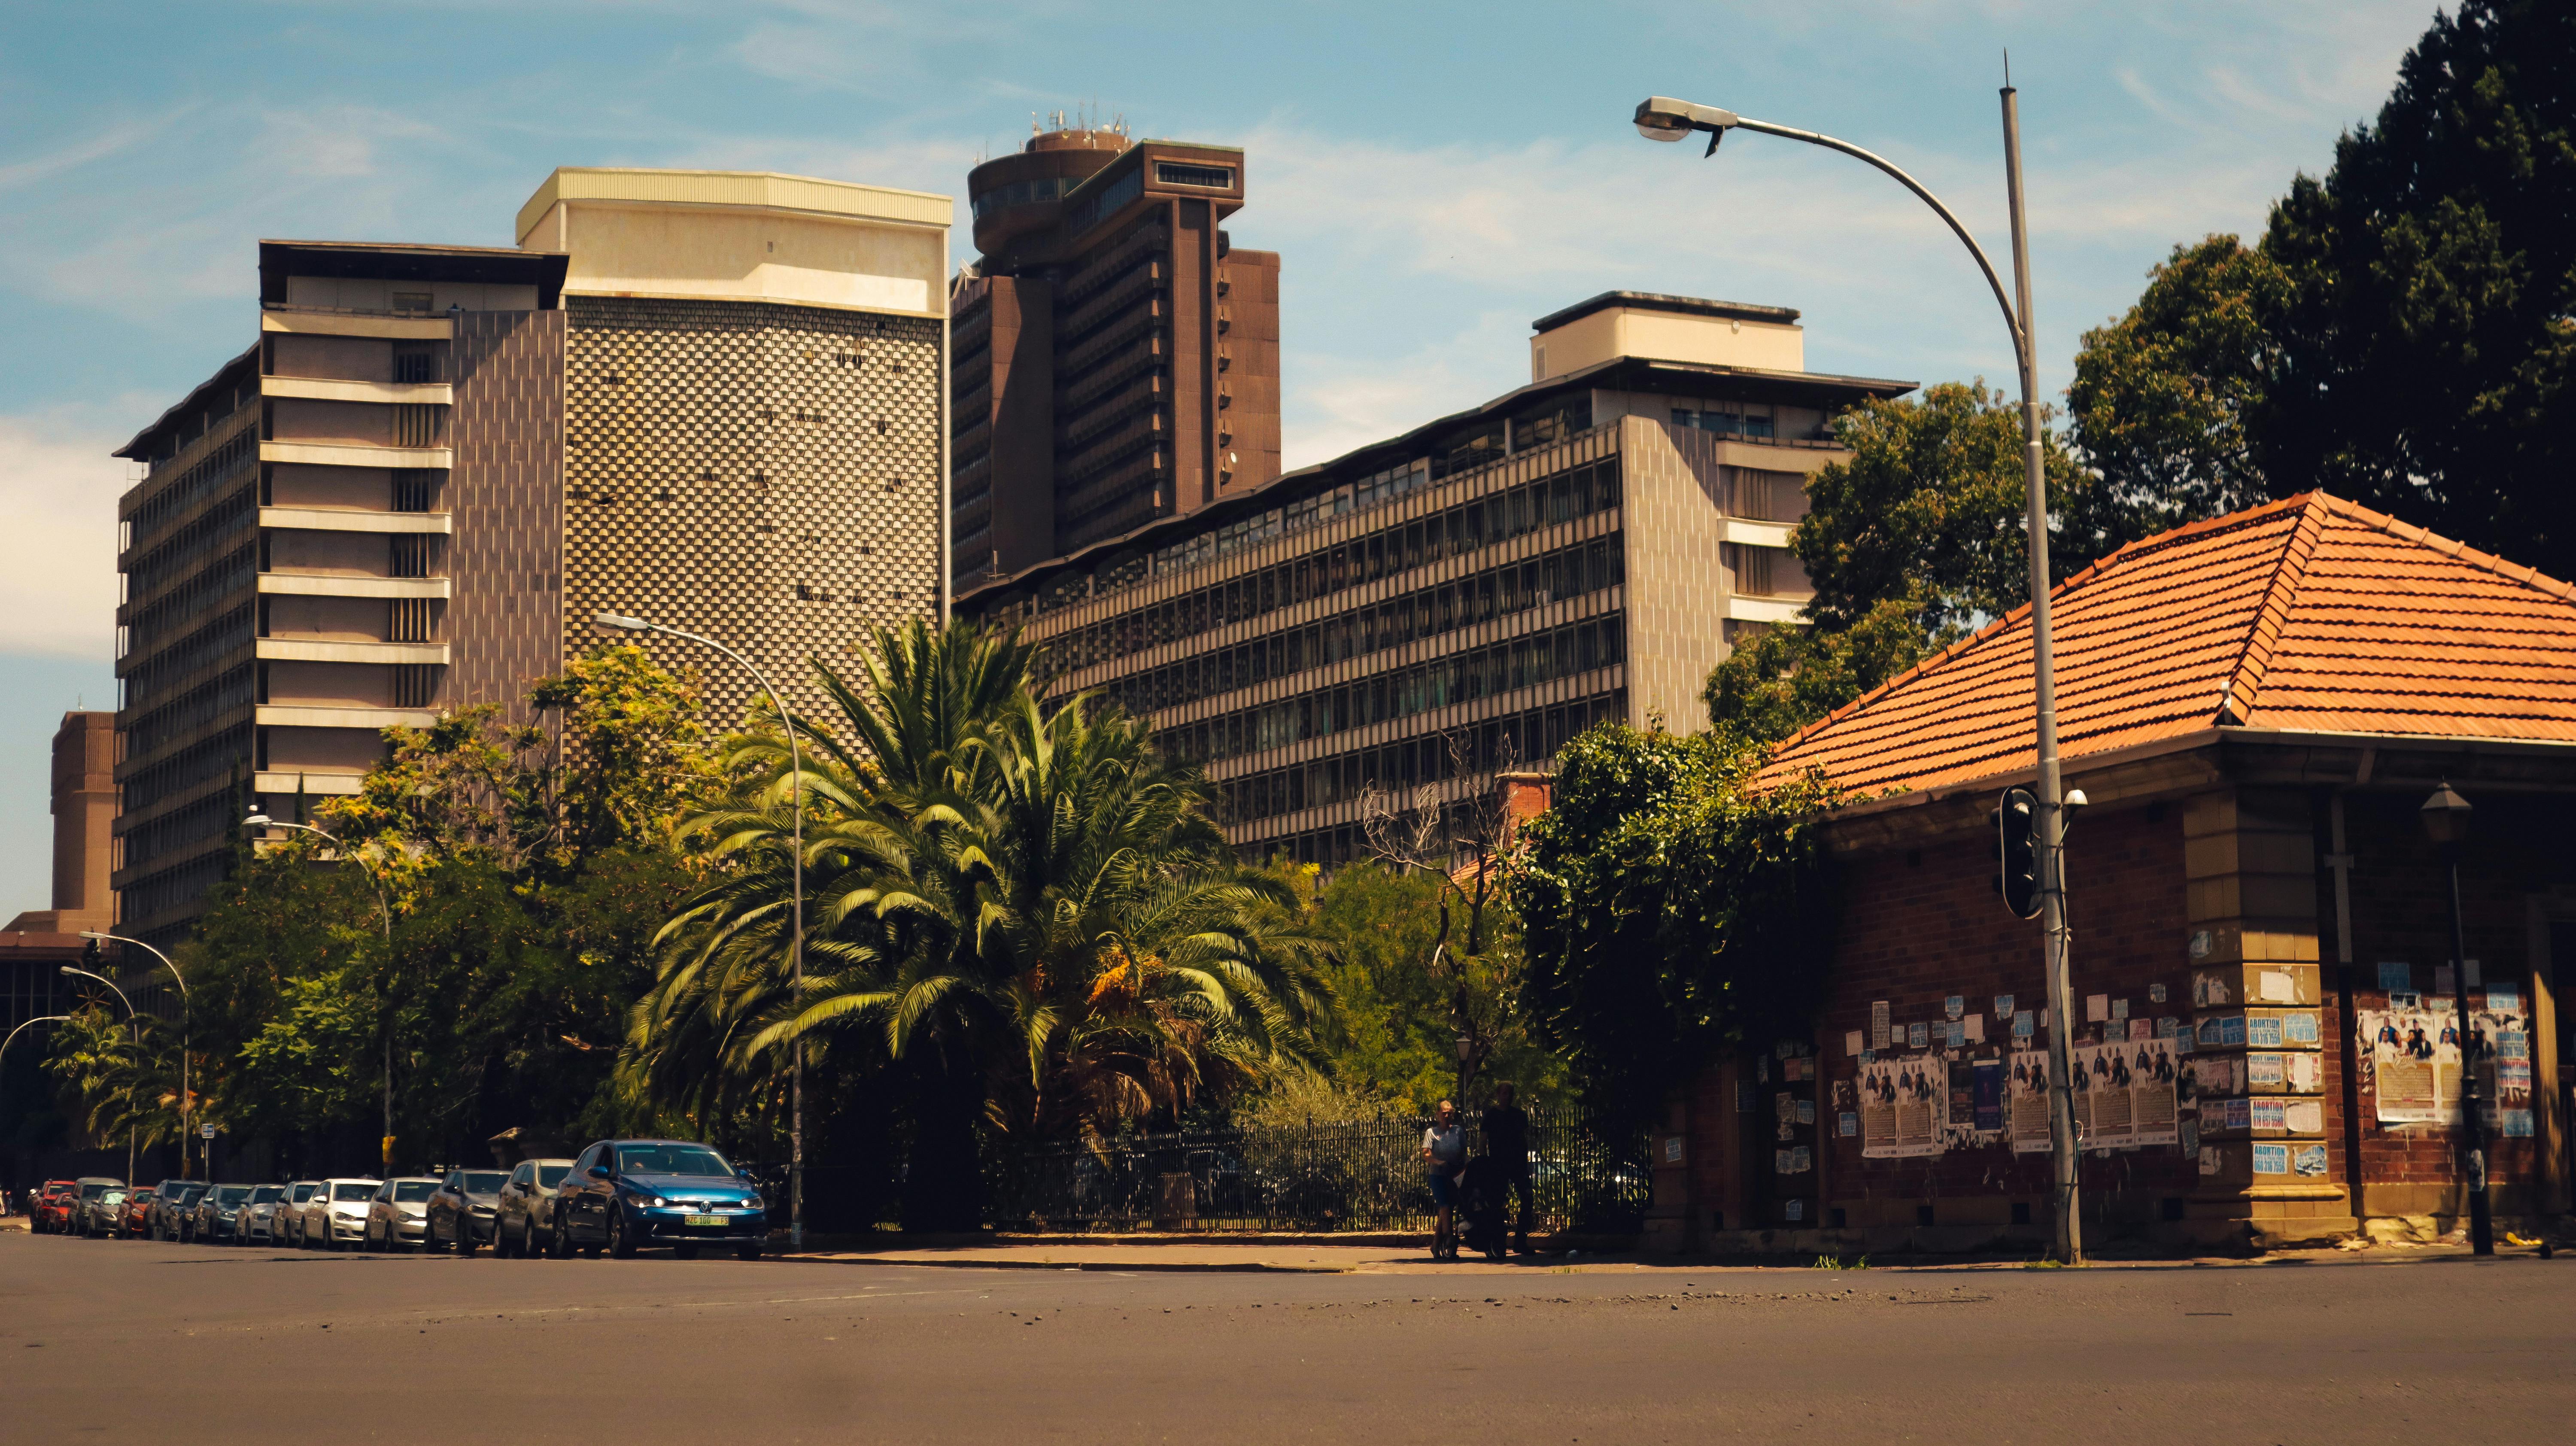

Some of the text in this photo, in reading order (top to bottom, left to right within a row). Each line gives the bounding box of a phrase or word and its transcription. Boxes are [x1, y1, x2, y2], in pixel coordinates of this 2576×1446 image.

[2250, 1019, 2280, 1028] ABORTION
[2253, 1101, 2283, 1111] ABORTION
[2253, 1115, 2261, 1127] 078
[2262, 1115, 2270, 1127] 657
[2255, 1146, 2284, 1156] ABORTION
